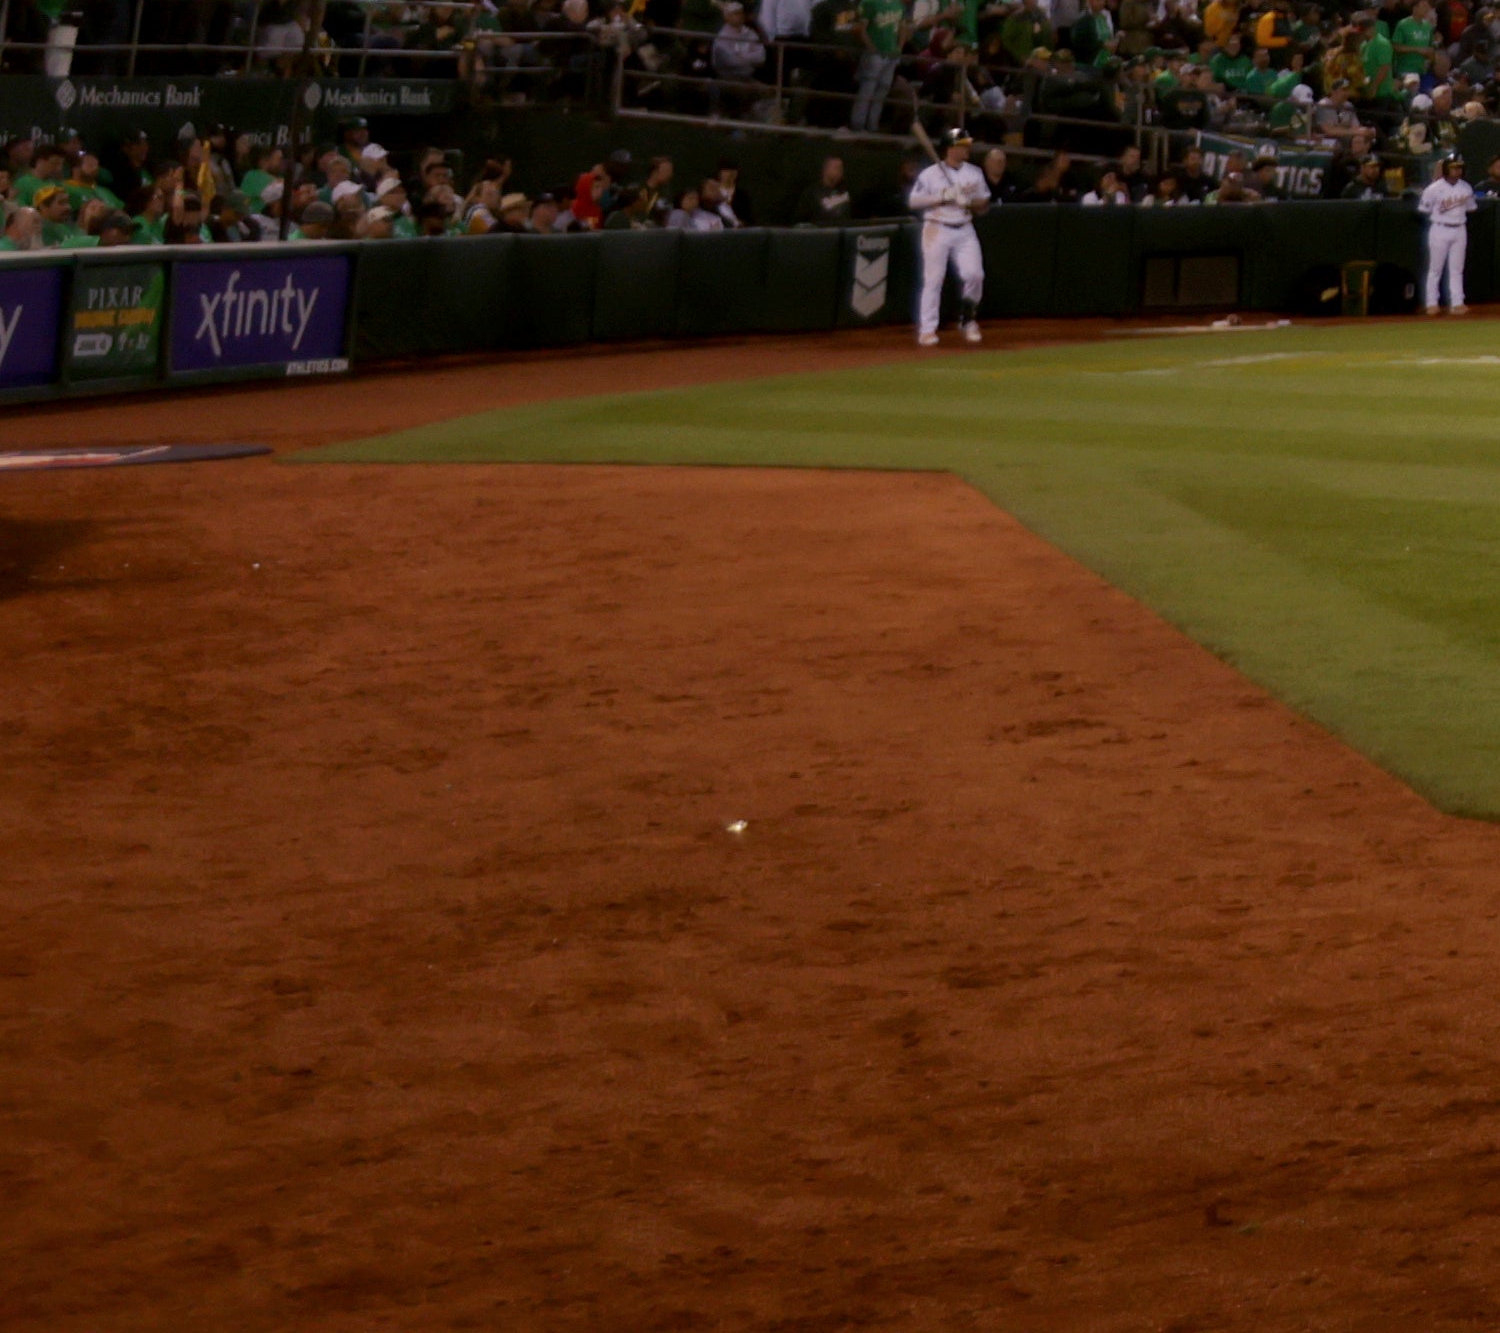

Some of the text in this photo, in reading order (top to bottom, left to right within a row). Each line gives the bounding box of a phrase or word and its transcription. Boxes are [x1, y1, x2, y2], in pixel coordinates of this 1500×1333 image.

[79, 83, 202, 107] Mechanics Bank
[324, 86, 431, 109] Mechanics Bank
[88, 285, 144, 309] PIXAR
[197, 270, 320, 357] xfinity
